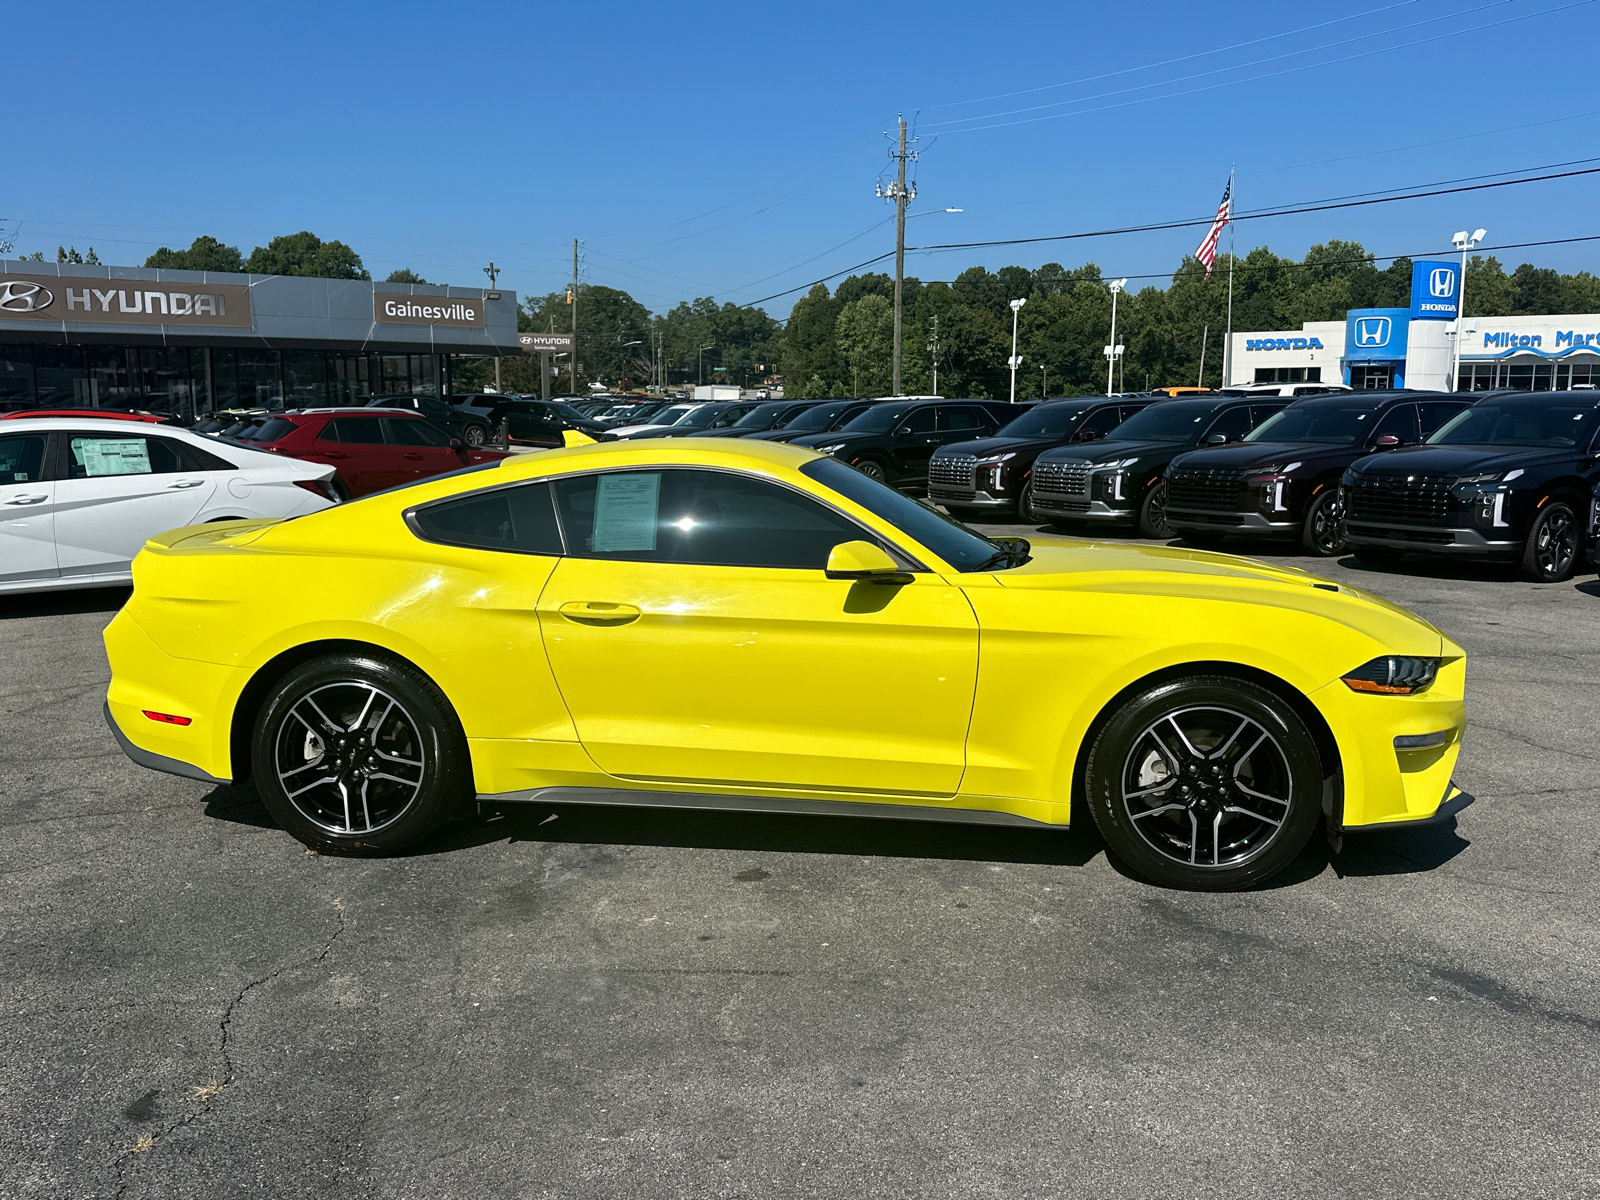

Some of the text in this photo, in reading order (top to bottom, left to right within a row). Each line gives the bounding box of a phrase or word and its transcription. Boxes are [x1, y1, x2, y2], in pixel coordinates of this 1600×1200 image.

[66, 288, 226, 316] HYUNDAI
[1421, 304, 1457, 312] HONDA
[385, 301, 475, 321] Gainesville
[534, 337, 570, 345] HYUNDAI
[1246, 338, 1324, 351] HONDA
[1484, 332, 1542, 347] Milton
[1105, 778, 1118, 827] EAGLE
